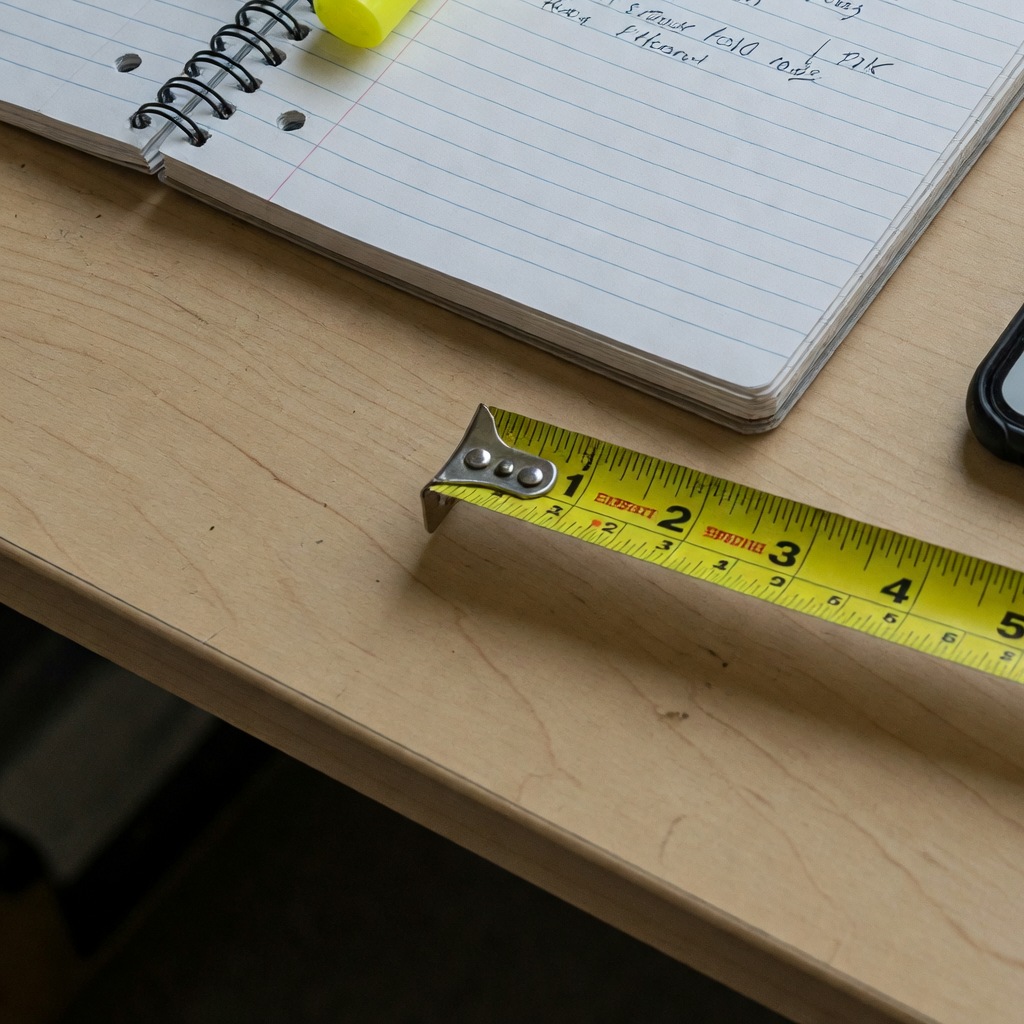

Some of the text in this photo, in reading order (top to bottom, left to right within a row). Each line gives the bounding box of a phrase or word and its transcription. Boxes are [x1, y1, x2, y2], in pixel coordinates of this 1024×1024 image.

[563, 474, 585, 498] 1
[656, 505, 693, 534] 2
[768, 541, 801, 567] 3
[880, 577, 913, 605] 4
